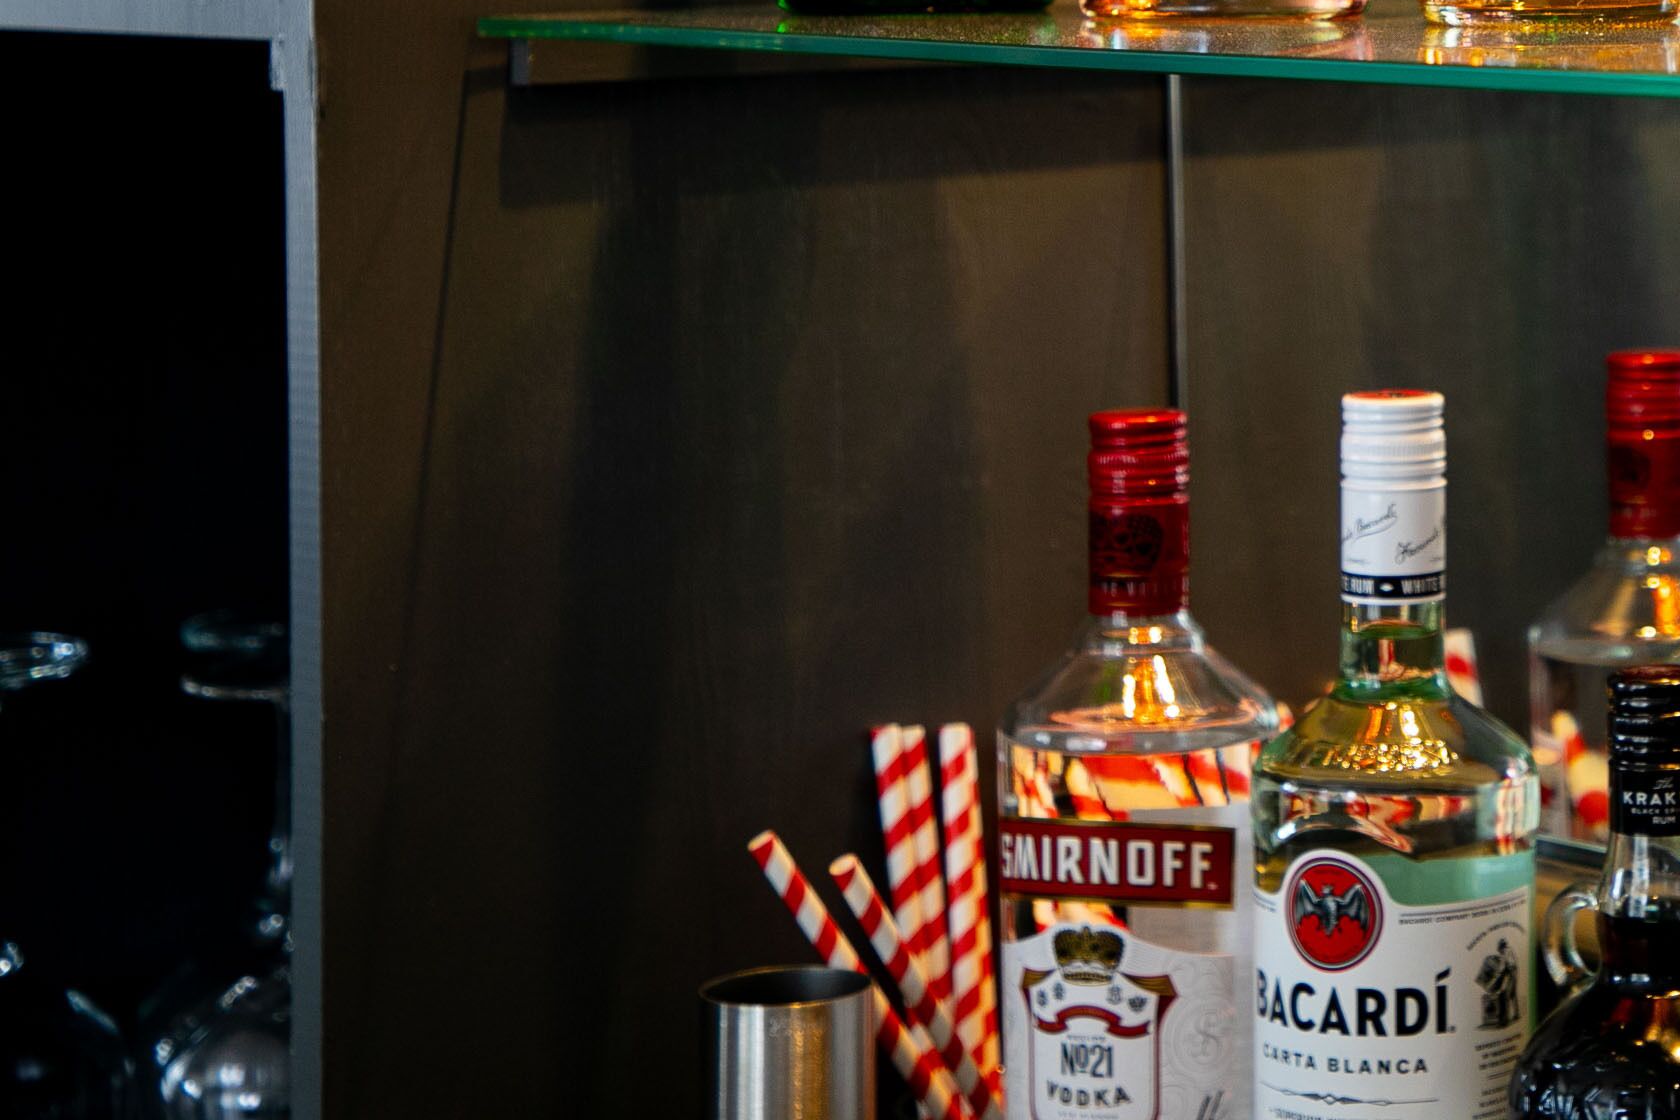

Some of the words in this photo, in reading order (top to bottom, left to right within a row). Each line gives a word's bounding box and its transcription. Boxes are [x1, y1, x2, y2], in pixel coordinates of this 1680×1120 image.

[1652, 816, 1676, 825] RUM
[1001, 833, 1214, 889] SMIRNOFF
[1256, 965, 1452, 1037] BACARDÍ
[1263, 1043, 1317, 1070] CARTA
[1327, 1057, 1428, 1074] BLANCA
[1047, 1079, 1132, 1108] VODKA
